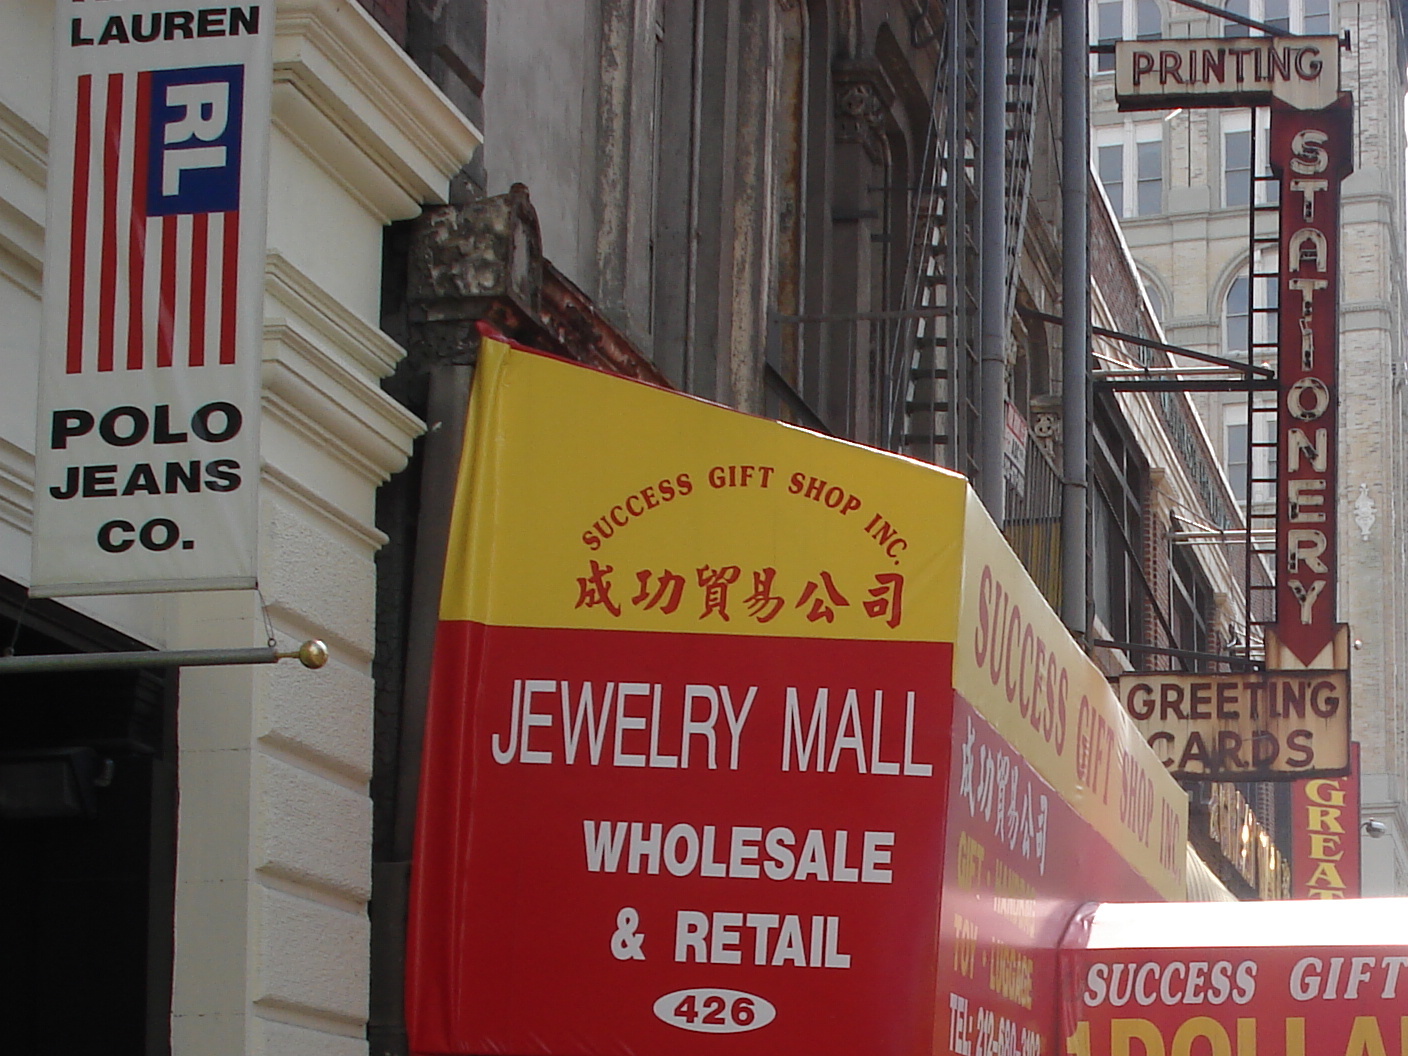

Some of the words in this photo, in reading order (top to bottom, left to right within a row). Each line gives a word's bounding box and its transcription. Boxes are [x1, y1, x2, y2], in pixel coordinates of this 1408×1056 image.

[71, 6, 260, 46] LAUREN
[1132, 46, 1323, 86] PRINTING
[162, 81, 229, 197] RL
[1288, 129, 1329, 627] STATIONERY
[50, 401, 242, 449] POLO
[49, 459, 241, 499] JEANS
[97, 518, 194, 553] CO.
[582, 473, 693, 551] SUCCESS
[708, 466, 774, 489] GIFT
[788, 472, 861, 516] SHOP
[864, 513, 907, 565] INC.
[574, 559, 905, 629] 成功貿易公司
[492, 679, 758, 770] JEWELRY
[781, 686, 932, 777] MALL
[974, 565, 1069, 756] SUCCESS
[1076, 695, 1115, 805] GIFT
[1120, 750, 1154, 848] SHOP
[1126, 680, 1340, 721] GREETING
[1147, 728, 1315, 768] CARDS
[960, 715, 1048, 877] 成功貿易公司
[583, 820, 895, 884] WHOLESALE
[610, 907, 645, 961] &
[675, 911, 850, 969] RETAIL
[954, 913, 978, 980] TOY
[673, 995, 756, 1026] 426
[1083, 960, 1258, 1008] SUCCESS
